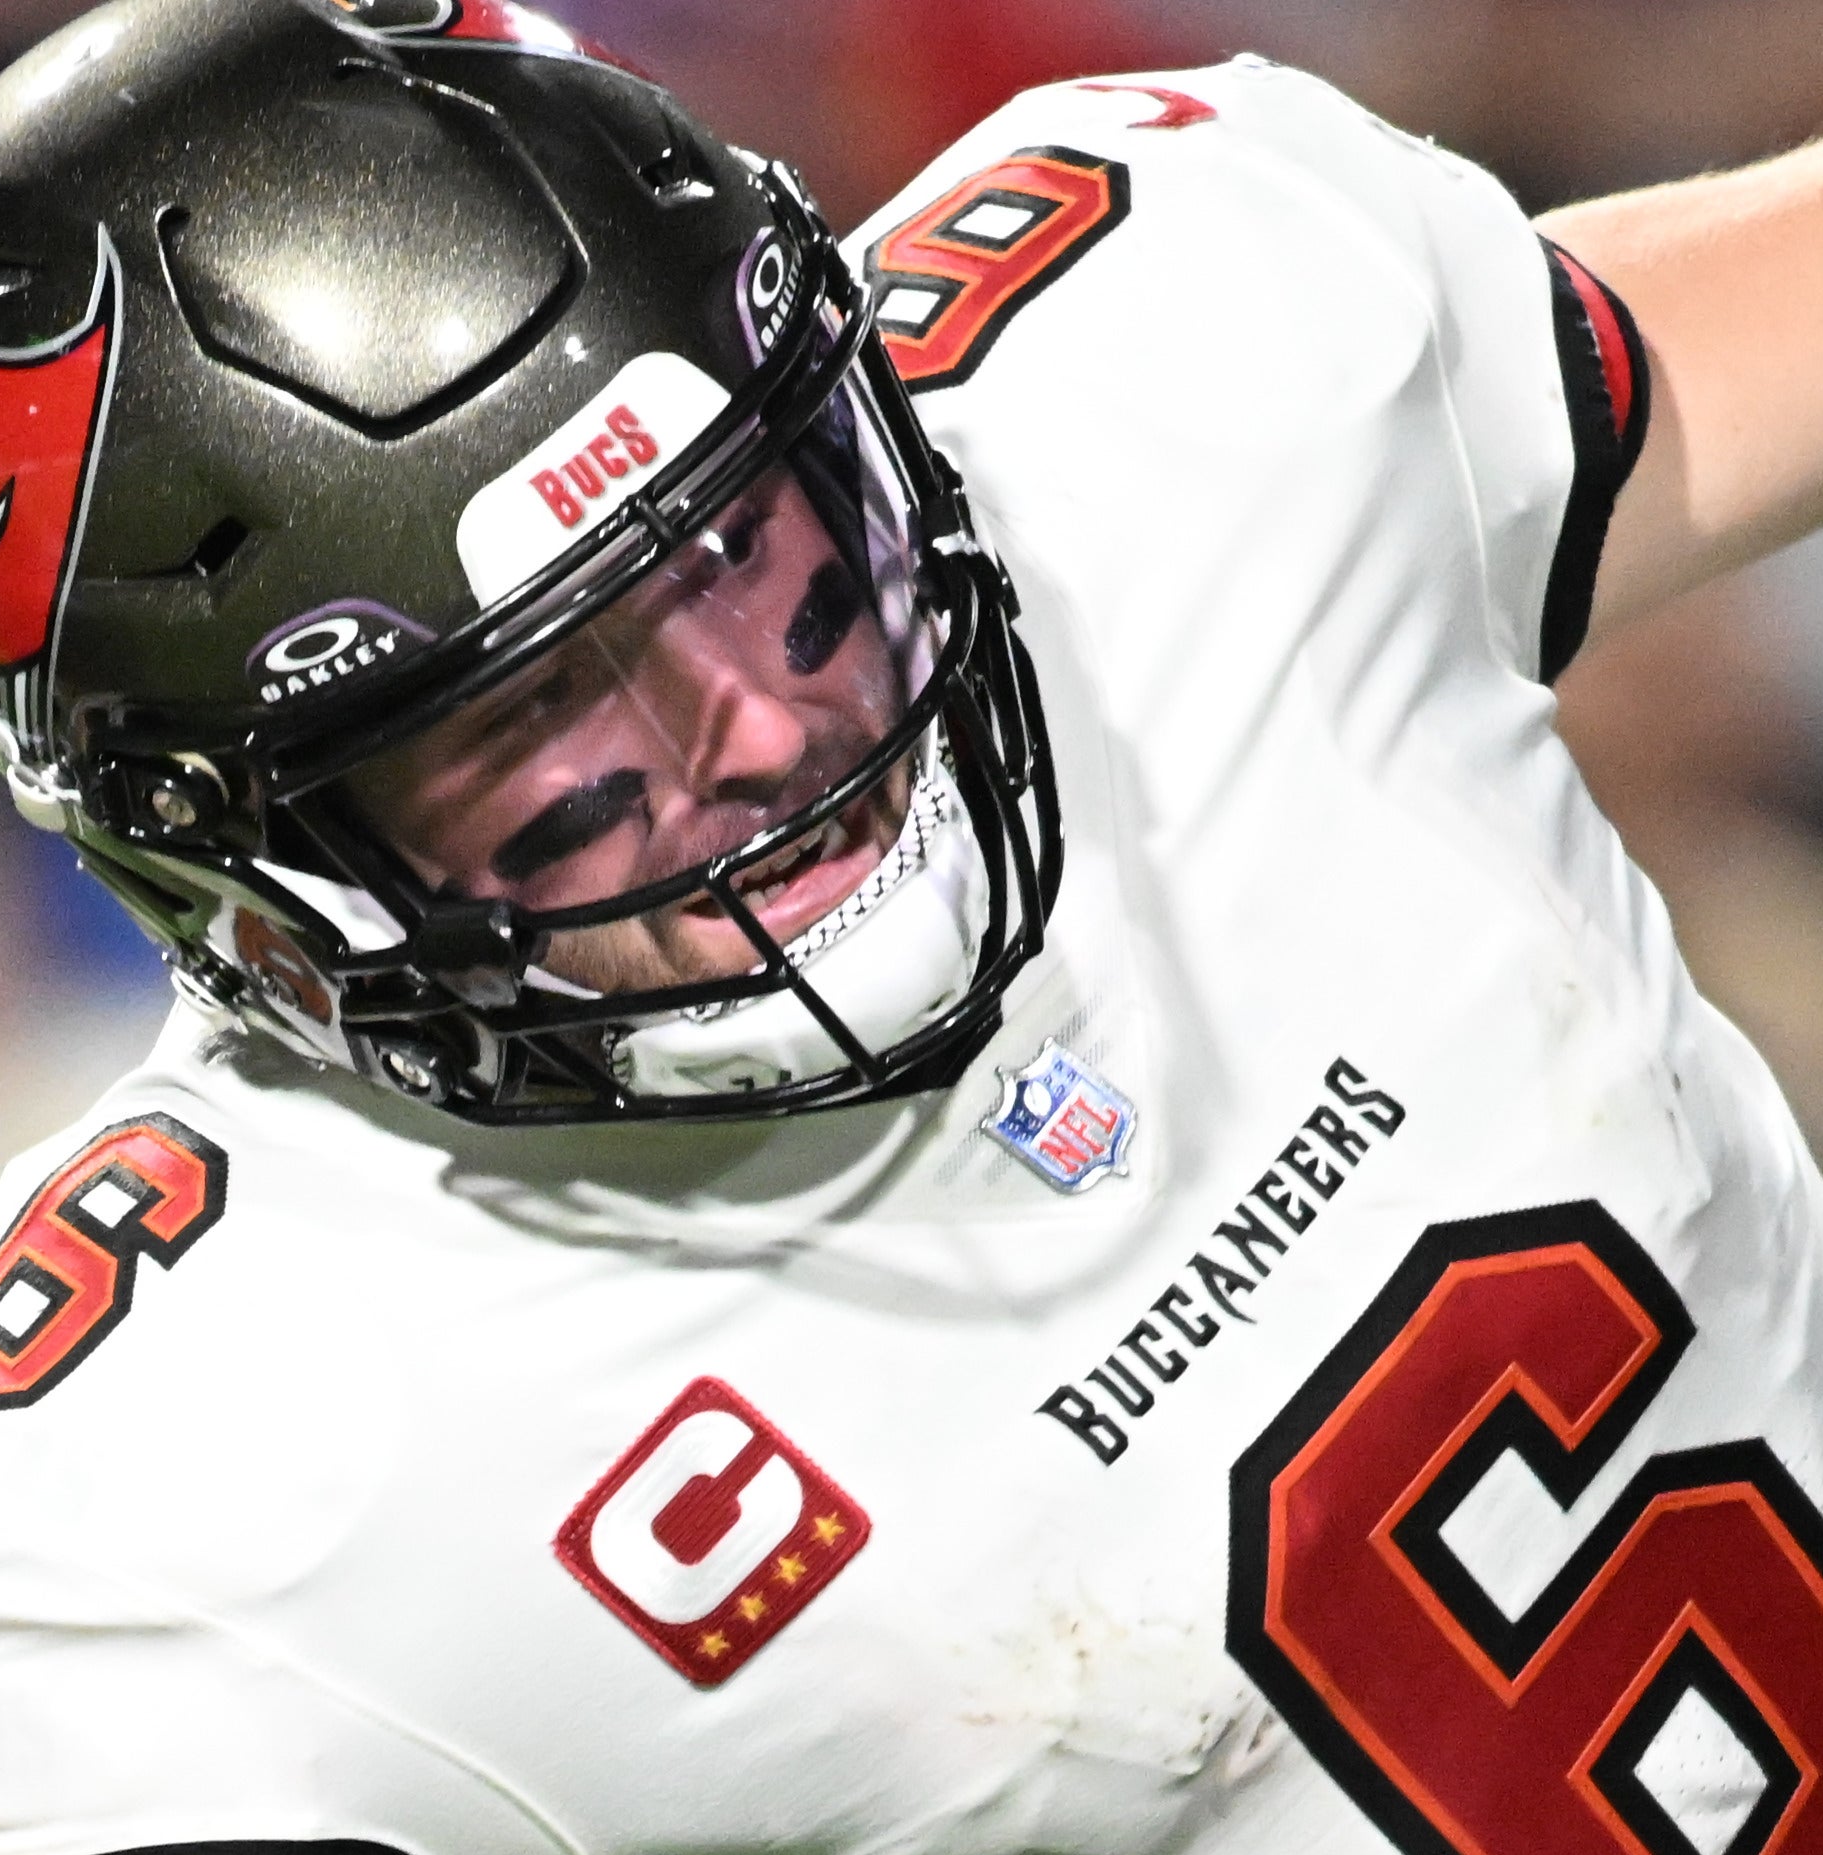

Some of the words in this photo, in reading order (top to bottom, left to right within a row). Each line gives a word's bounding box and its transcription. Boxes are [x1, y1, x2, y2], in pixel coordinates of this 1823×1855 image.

[528, 403, 659, 529] BUCS
[260, 627, 401, 704] OAKLEY
[1038, 1094, 1121, 1175] NFL
[1033, 1055, 1407, 1467] BUCCANEERS
[588, 1409, 804, 1624] C
